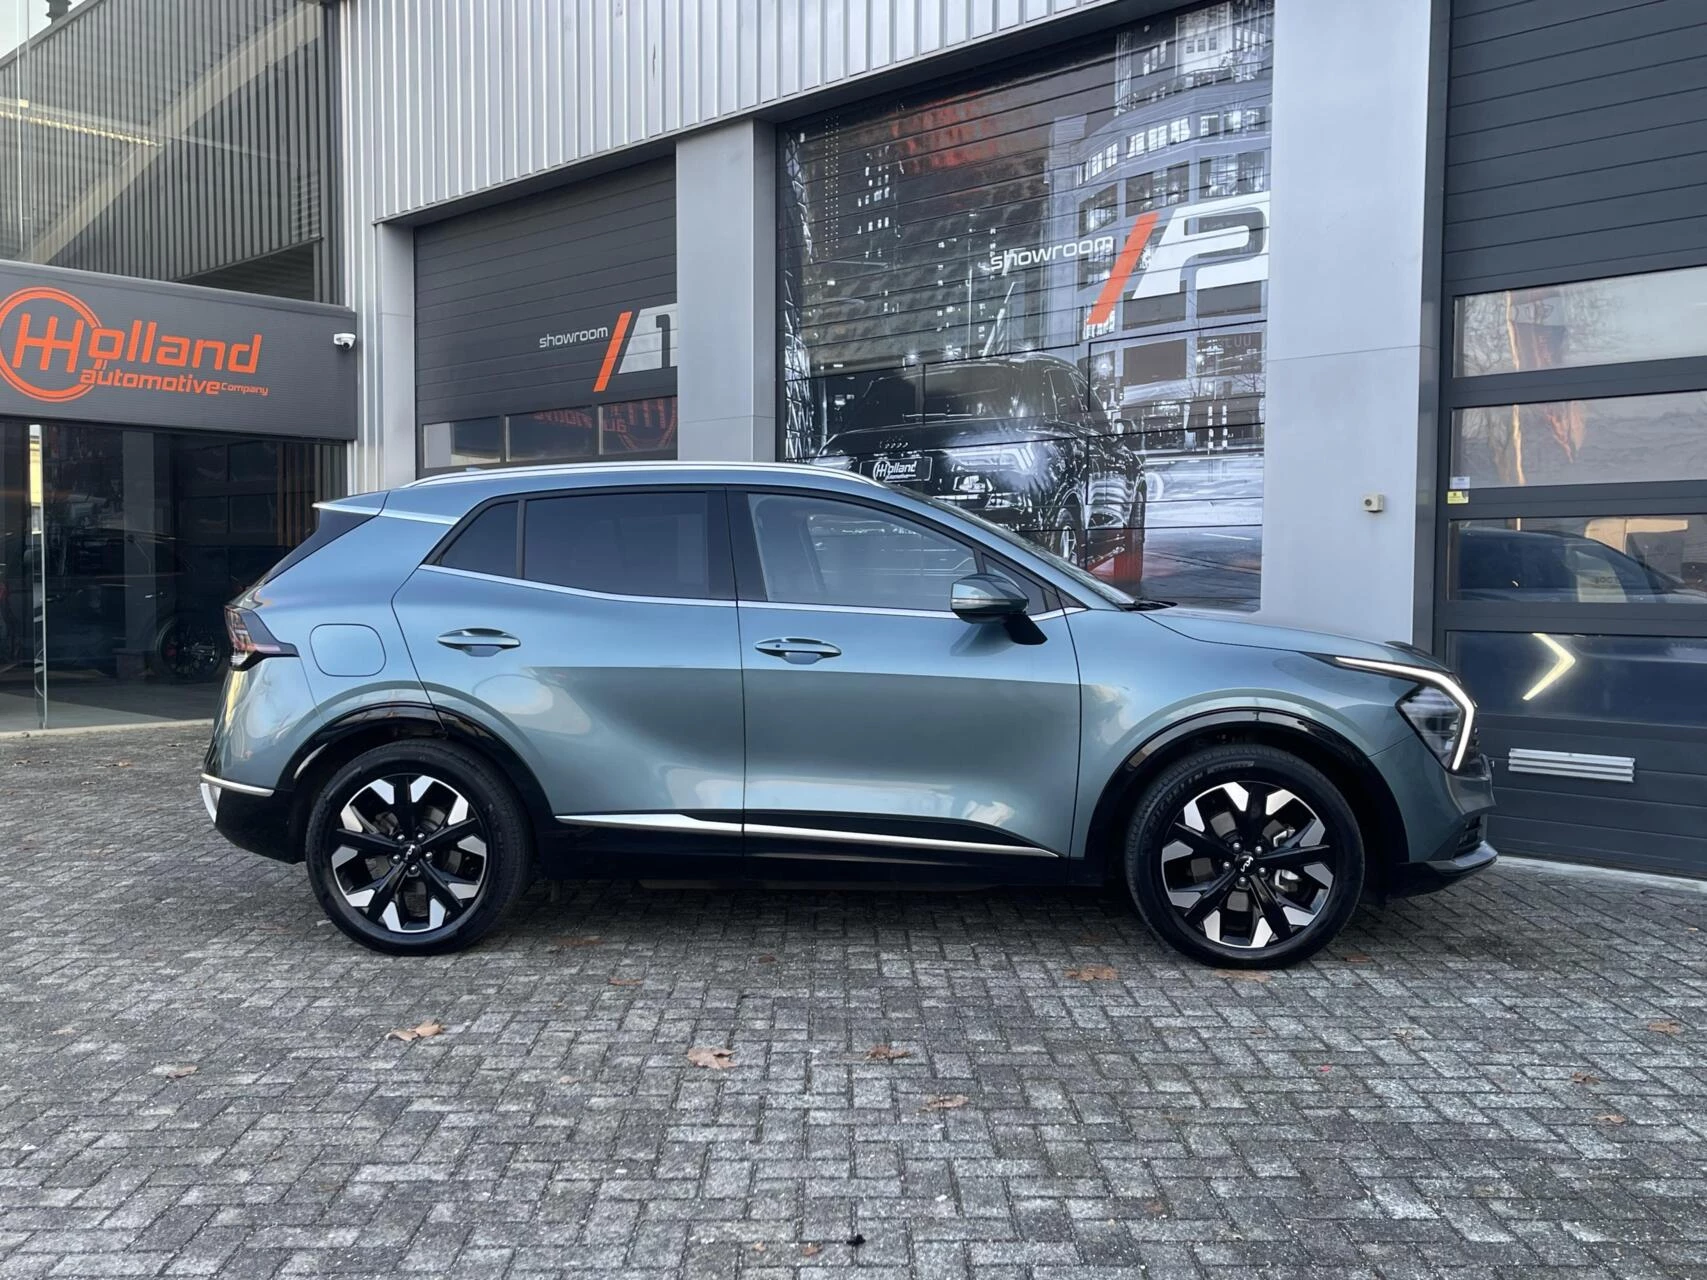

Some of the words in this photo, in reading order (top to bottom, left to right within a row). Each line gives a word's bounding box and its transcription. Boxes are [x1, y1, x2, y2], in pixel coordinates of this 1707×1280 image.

[988, 236, 1115, 270] showroom
[539, 327, 608, 348] showroom
[80, 367, 221, 395] automotive
[221, 382, 269, 396] Company
